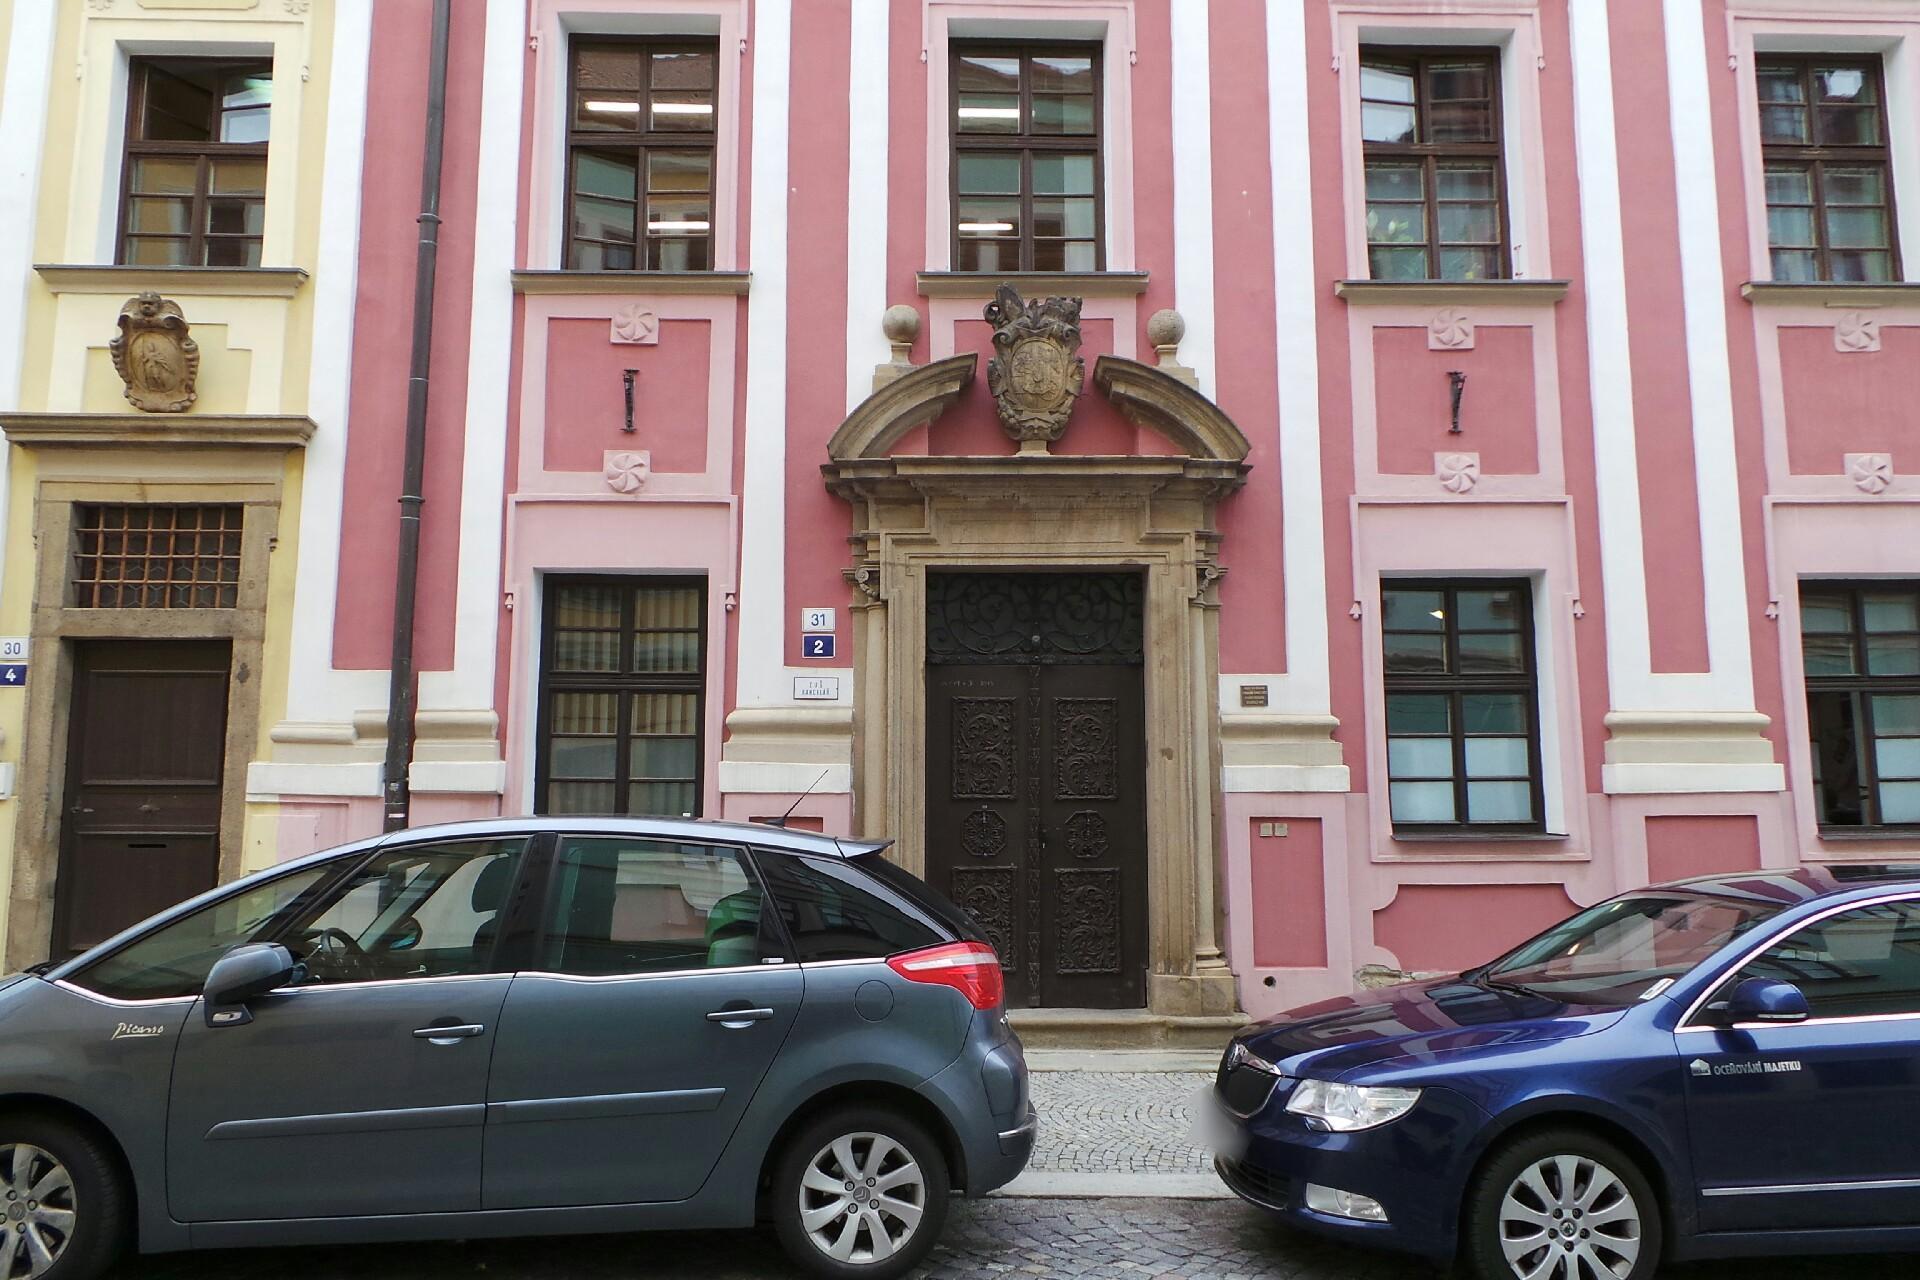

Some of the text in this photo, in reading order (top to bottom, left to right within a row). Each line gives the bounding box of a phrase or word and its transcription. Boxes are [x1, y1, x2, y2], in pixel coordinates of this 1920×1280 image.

[811, 613, 826, 626] 31
[4, 642, 21, 655] 30
[813, 640, 824, 653] 2
[5, 668, 17, 682] 4
[110, 1022, 165, 1041] Picasso
[1763, 1060, 1802, 1073] MAJETKU
